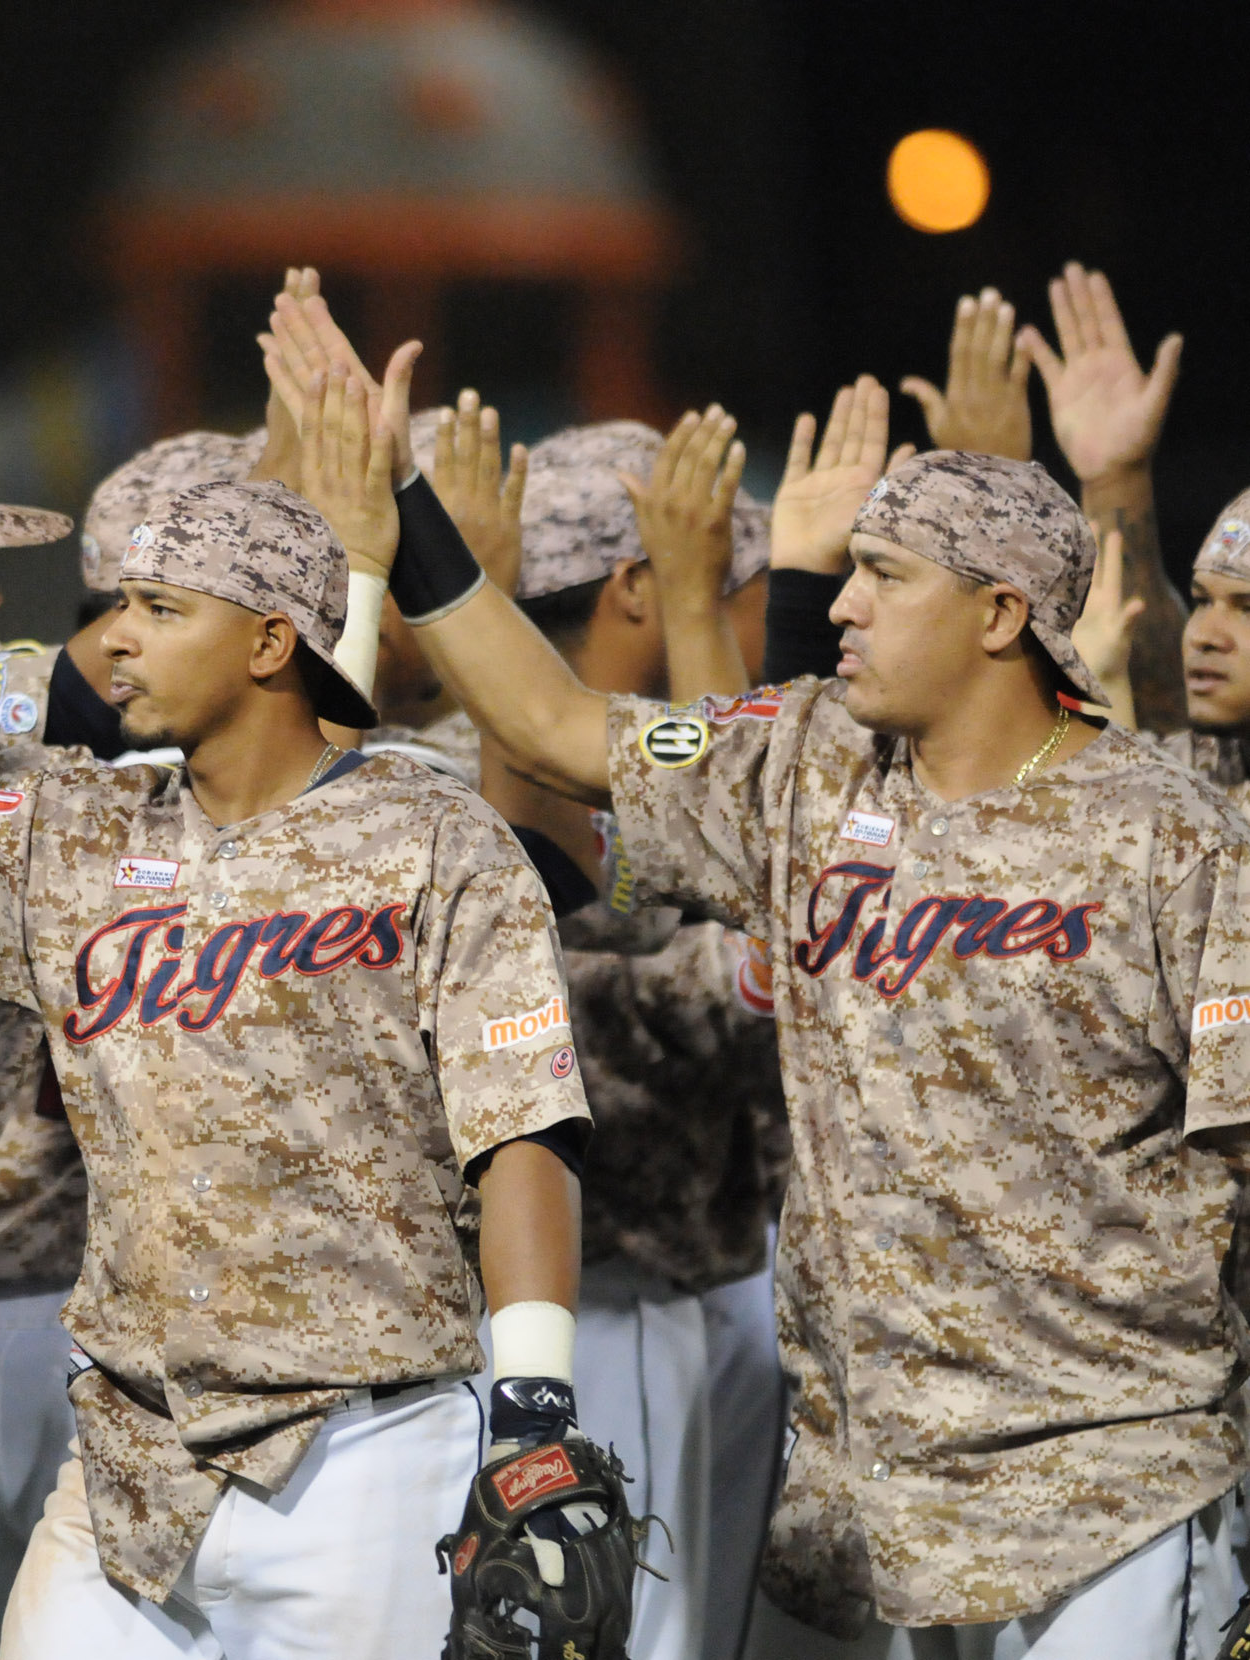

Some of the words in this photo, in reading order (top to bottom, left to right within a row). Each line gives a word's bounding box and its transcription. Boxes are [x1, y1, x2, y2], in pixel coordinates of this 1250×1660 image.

[653, 726, 699, 753] 11
[63, 901, 407, 1044] Tigres
[795, 861, 1101, 999] Tigres
